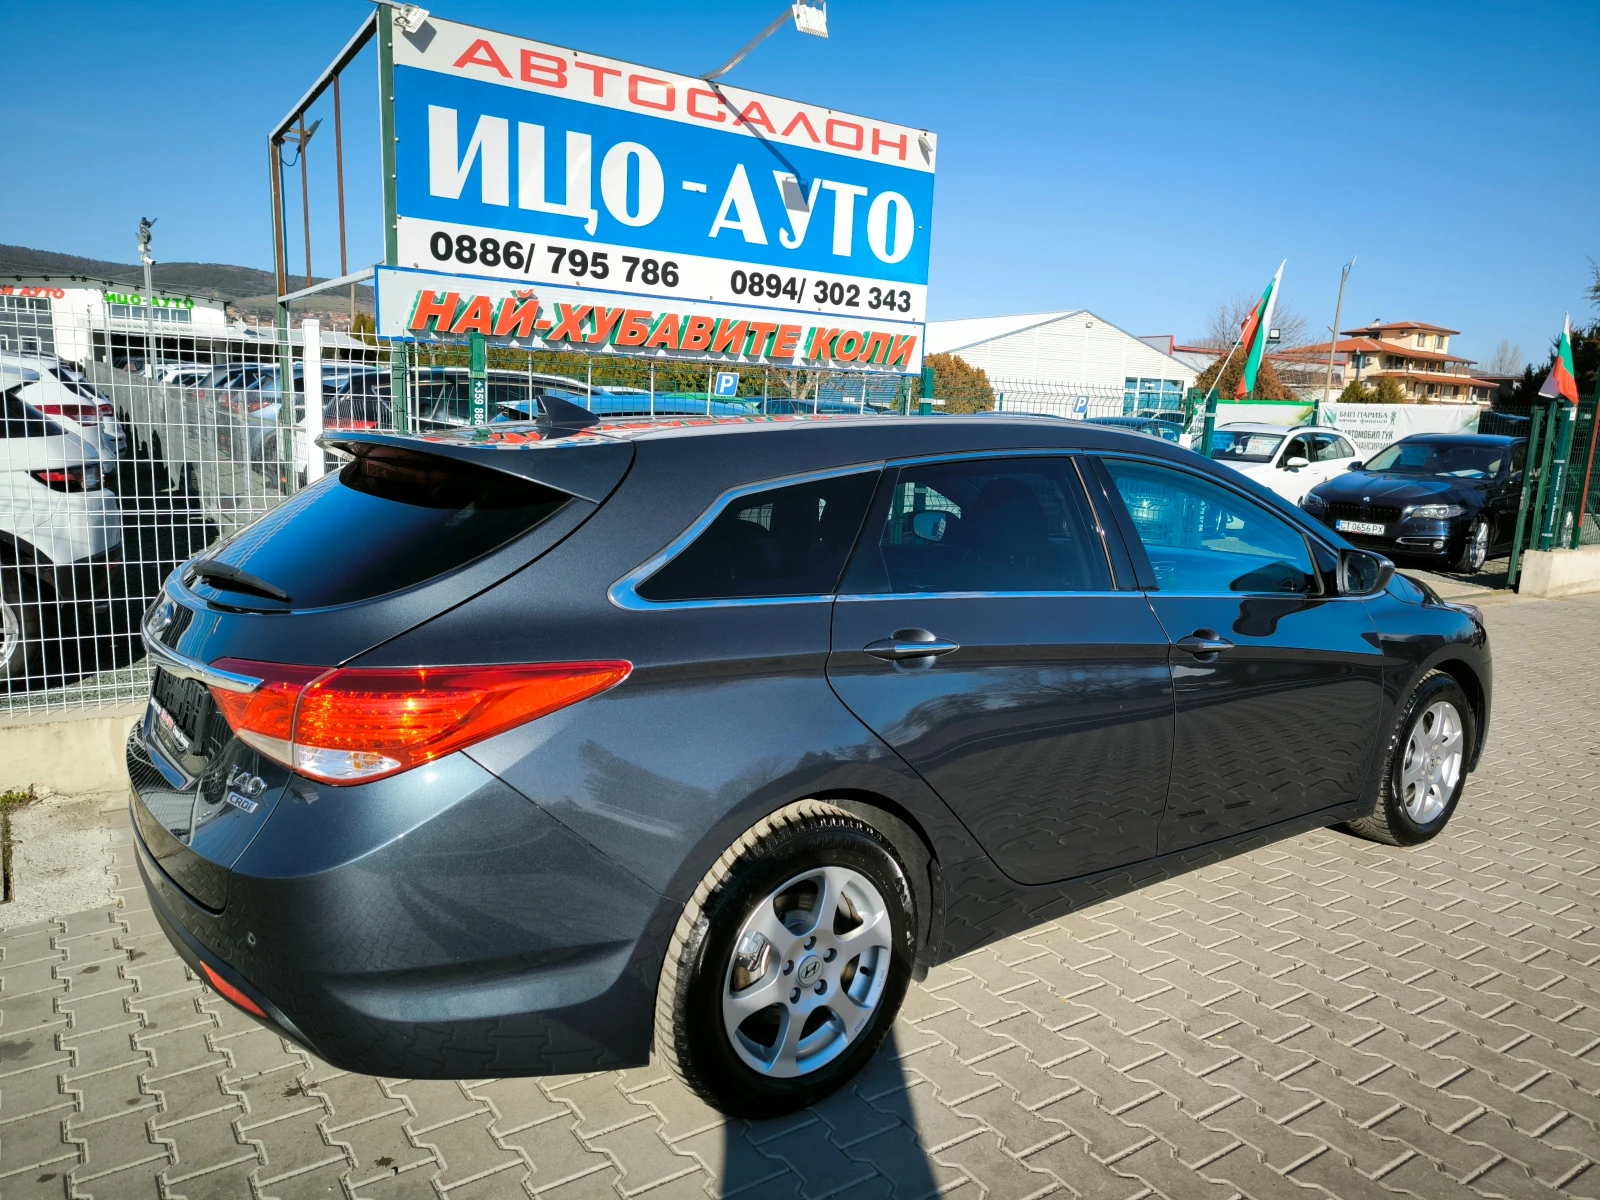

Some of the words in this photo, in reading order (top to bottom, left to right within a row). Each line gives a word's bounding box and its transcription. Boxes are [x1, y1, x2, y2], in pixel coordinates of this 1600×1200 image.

[452, 38, 908, 161] АВТОСАЛОН
[429, 231, 536, 273] 0886/
[547, 246, 610, 279] 795
[621, 255, 680, 288] 786
[730, 270, 807, 304] 0894/
[814, 280, 861, 308] 302
[868, 287, 912, 312] 343
[19, 286, 65, 299] АУТО
[407, 288, 802, 359] НАЙ-ХУБАВИТЕ
[803, 326, 918, 367] КОЛИ
[474, 380, 485, 405] +359
[719, 374, 734, 394] P
[1076, 397, 1087, 411] P
[1357, 411, 1388, 419] ПАРИБА
[1382, 431, 1394, 440] ТУК
[1340, 521, 1351, 530] CT
[1351, 522, 1371, 532] 0656
